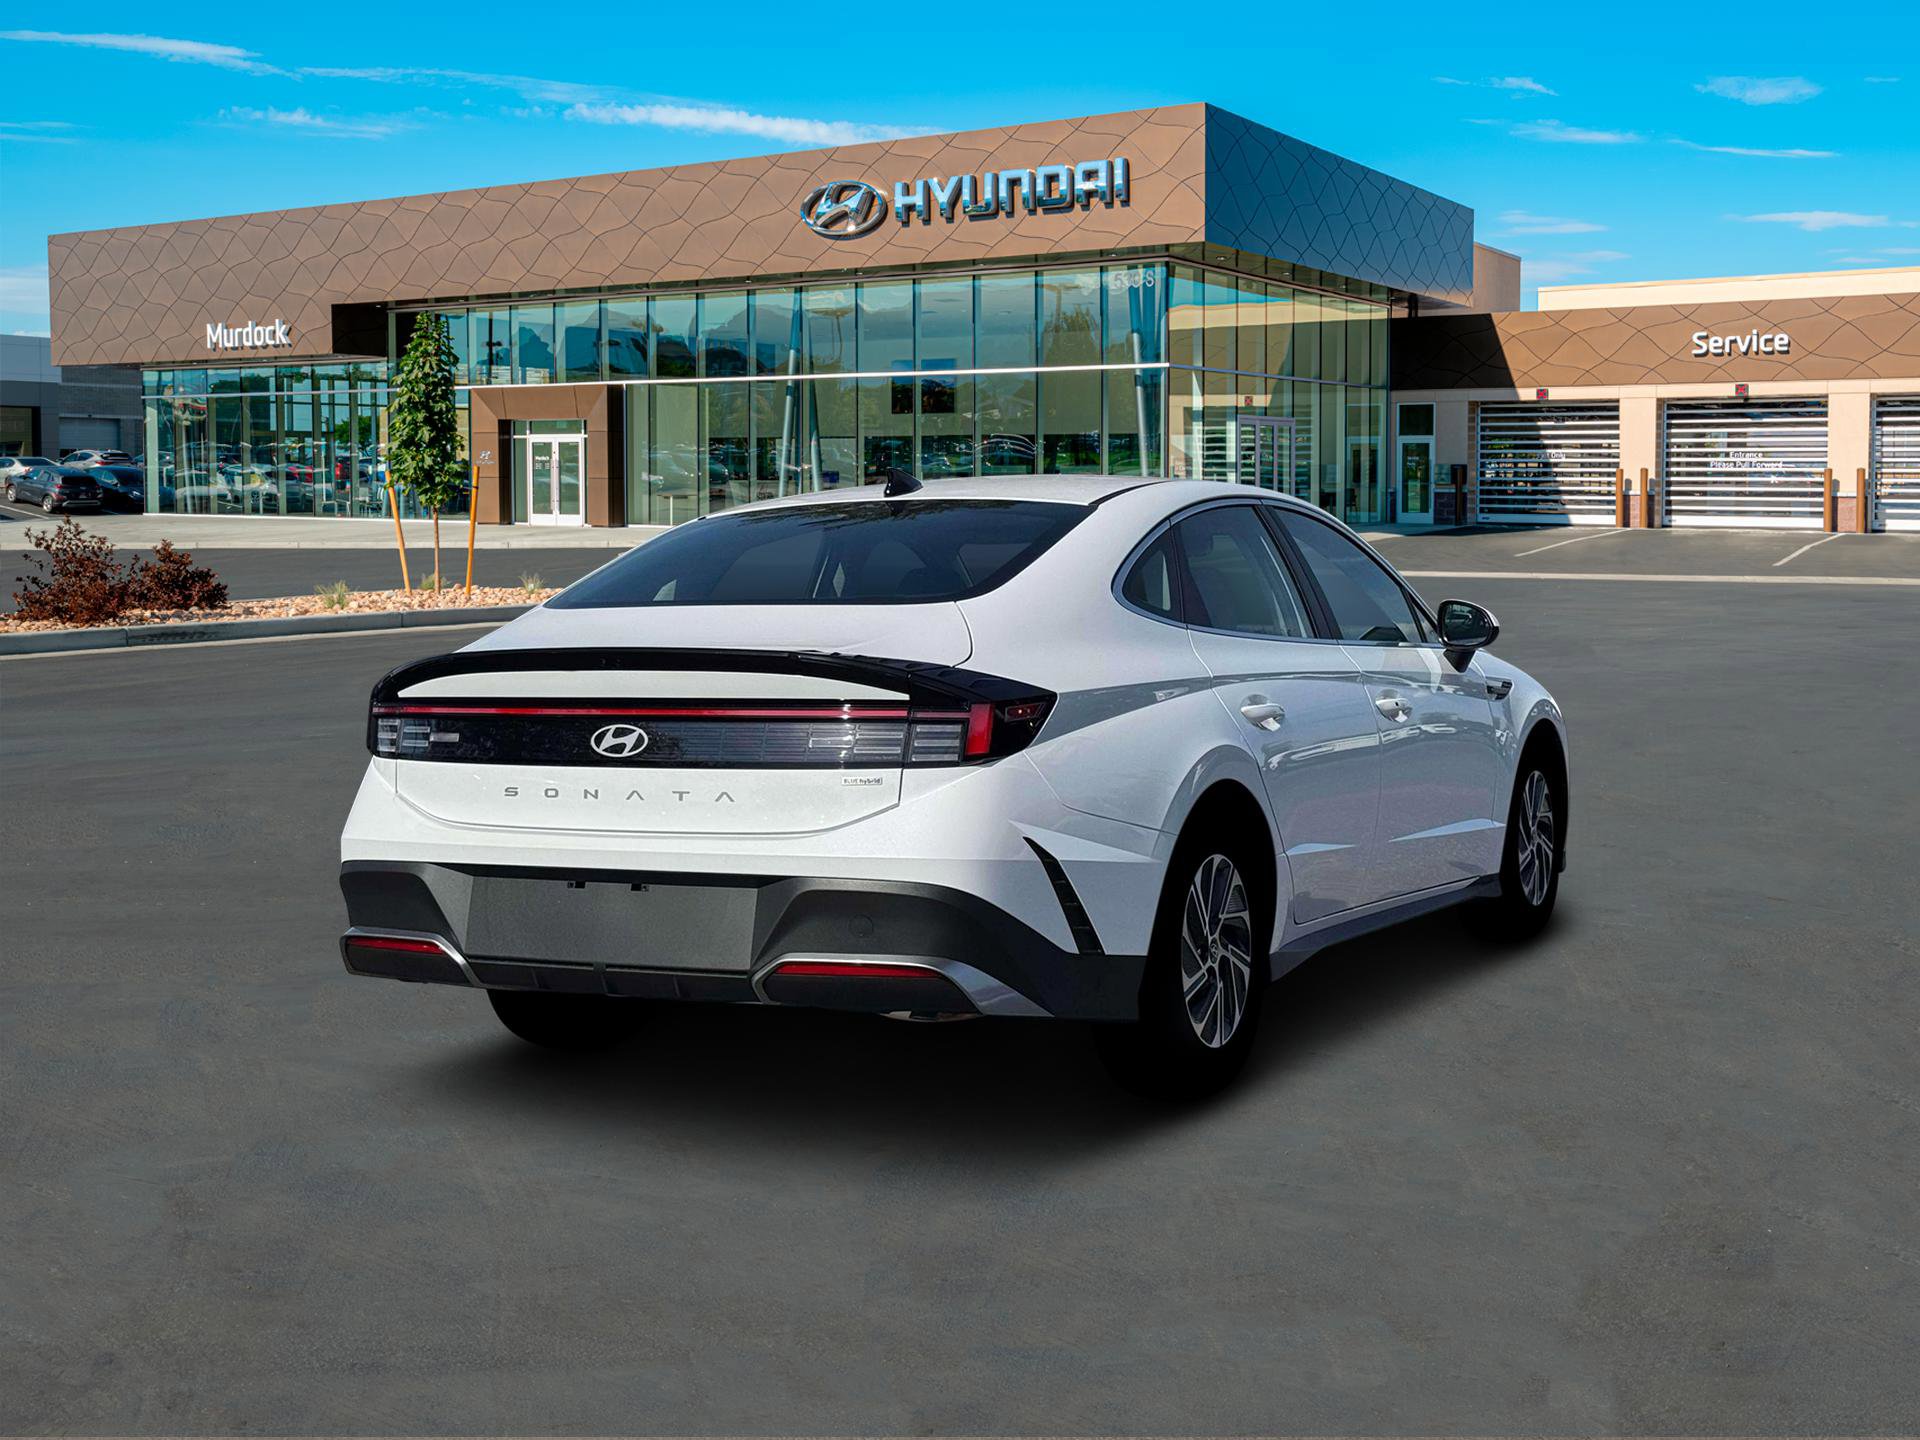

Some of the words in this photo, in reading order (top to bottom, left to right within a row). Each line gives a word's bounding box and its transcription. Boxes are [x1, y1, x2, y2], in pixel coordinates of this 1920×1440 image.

[894, 156, 1130, 225] HYUNDAI
[206, 318, 290, 349] Murdock
[1691, 328, 1790, 355] Service
[1709, 460, 1735, 469] Please
[1735, 460, 1751, 469] Pull
[1751, 460, 1783, 469] Forward
[1729, 450, 1764, 459] Entrance
[503, 786, 736, 803] SONATA
